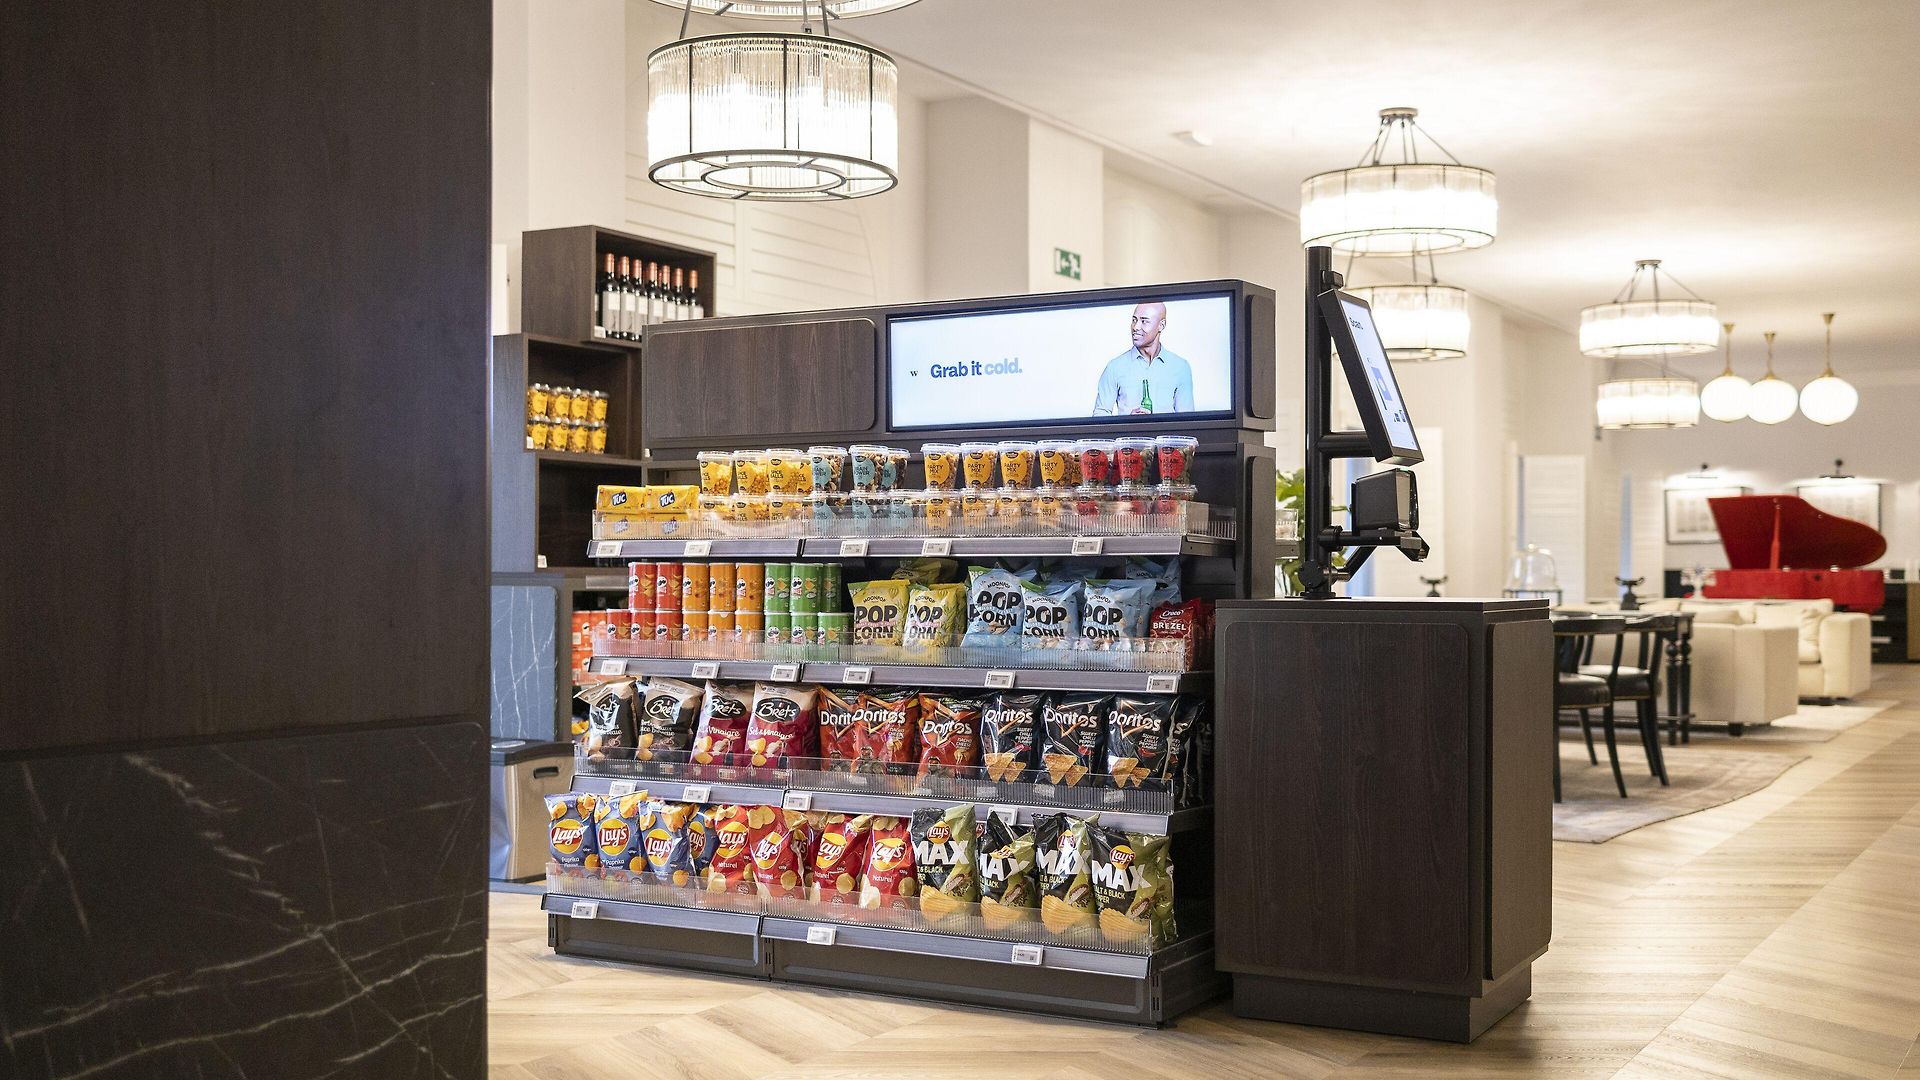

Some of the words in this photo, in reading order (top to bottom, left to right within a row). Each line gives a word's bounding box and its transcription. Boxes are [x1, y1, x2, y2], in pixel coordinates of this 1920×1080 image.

[930, 361, 968, 378] Grab
[971, 360, 982, 376] it
[984, 357, 1023, 375] cold.
[612, 492, 627, 506] TUC
[660, 493, 675, 508] TUC
[977, 591, 1021, 610] POP
[856, 605, 898, 623] POP
[1025, 605, 1067, 625] POP
[854, 627, 894, 640] CORN
[1153, 620, 1187, 632] BREZEL
[759, 702, 797, 721] Brets
[821, 710, 857, 726] Dorit
[852, 709, 907, 725] Doritos
[985, 708, 1034, 725] Doritos
[1045, 707, 1099, 729] Doritos
[1108, 710, 1163, 732] Doritos
[600, 828, 628, 846] Lay's
[929, 824, 949, 839] Lay's
[913, 840, 970, 864] MAX
[1036, 848, 1093, 874] MAX
[1112, 850, 1134, 868] Lay's
[606, 859, 625, 867] Paprika
[1092, 860, 1150, 892] MAX
[1109, 889, 1125, 899] BLACK
